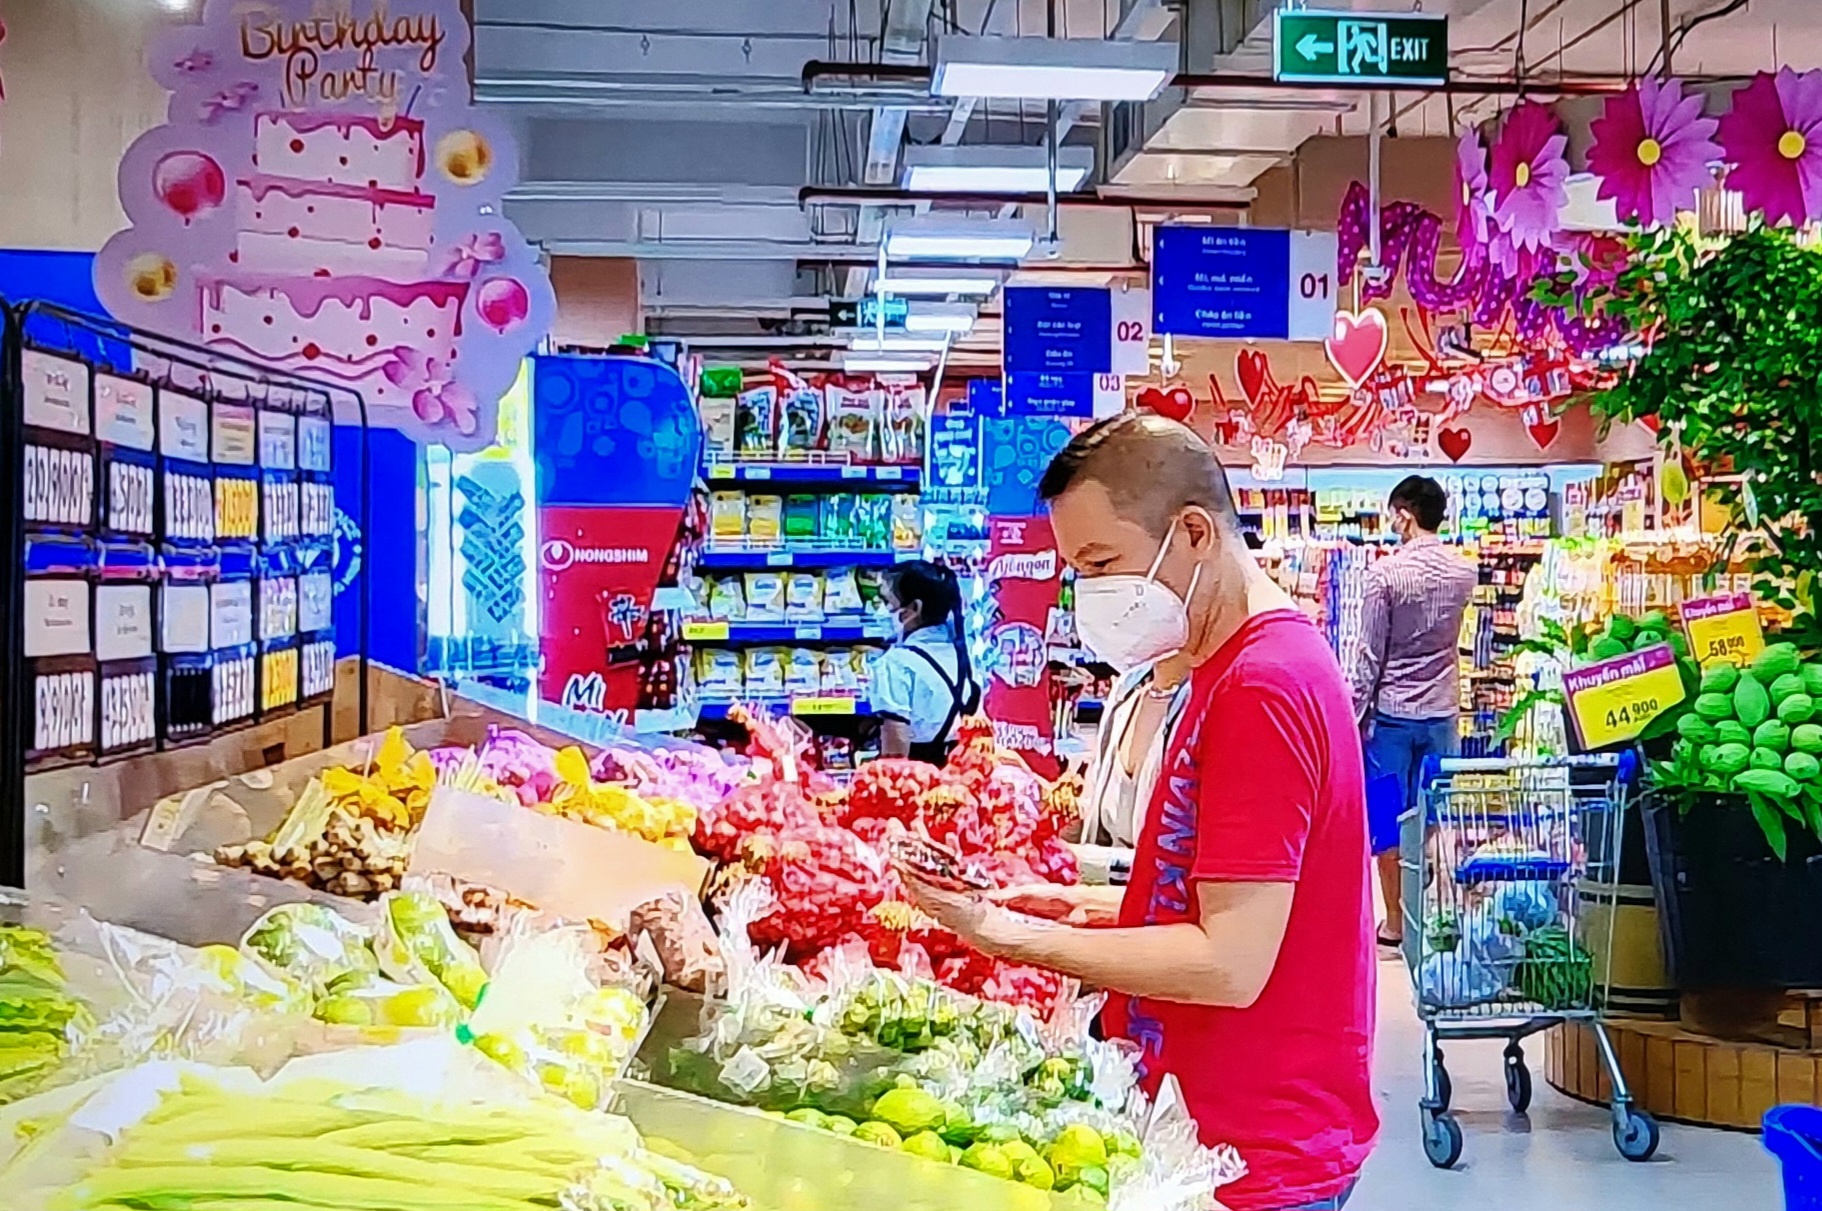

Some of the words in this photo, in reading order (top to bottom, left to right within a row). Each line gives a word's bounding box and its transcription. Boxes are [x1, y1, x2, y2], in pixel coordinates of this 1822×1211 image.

[240, 12, 447, 73] Birthday
[1390, 37, 1430, 62] EXIT
[285, 46, 397, 104] Party
[1299, 272, 1329, 300] 01
[1117, 321, 1144, 342] 02
[1099, 374, 1121, 391] 03
[575, 548, 648, 562] NONGSHIM
[1568, 666, 1619, 692] Khuyến
